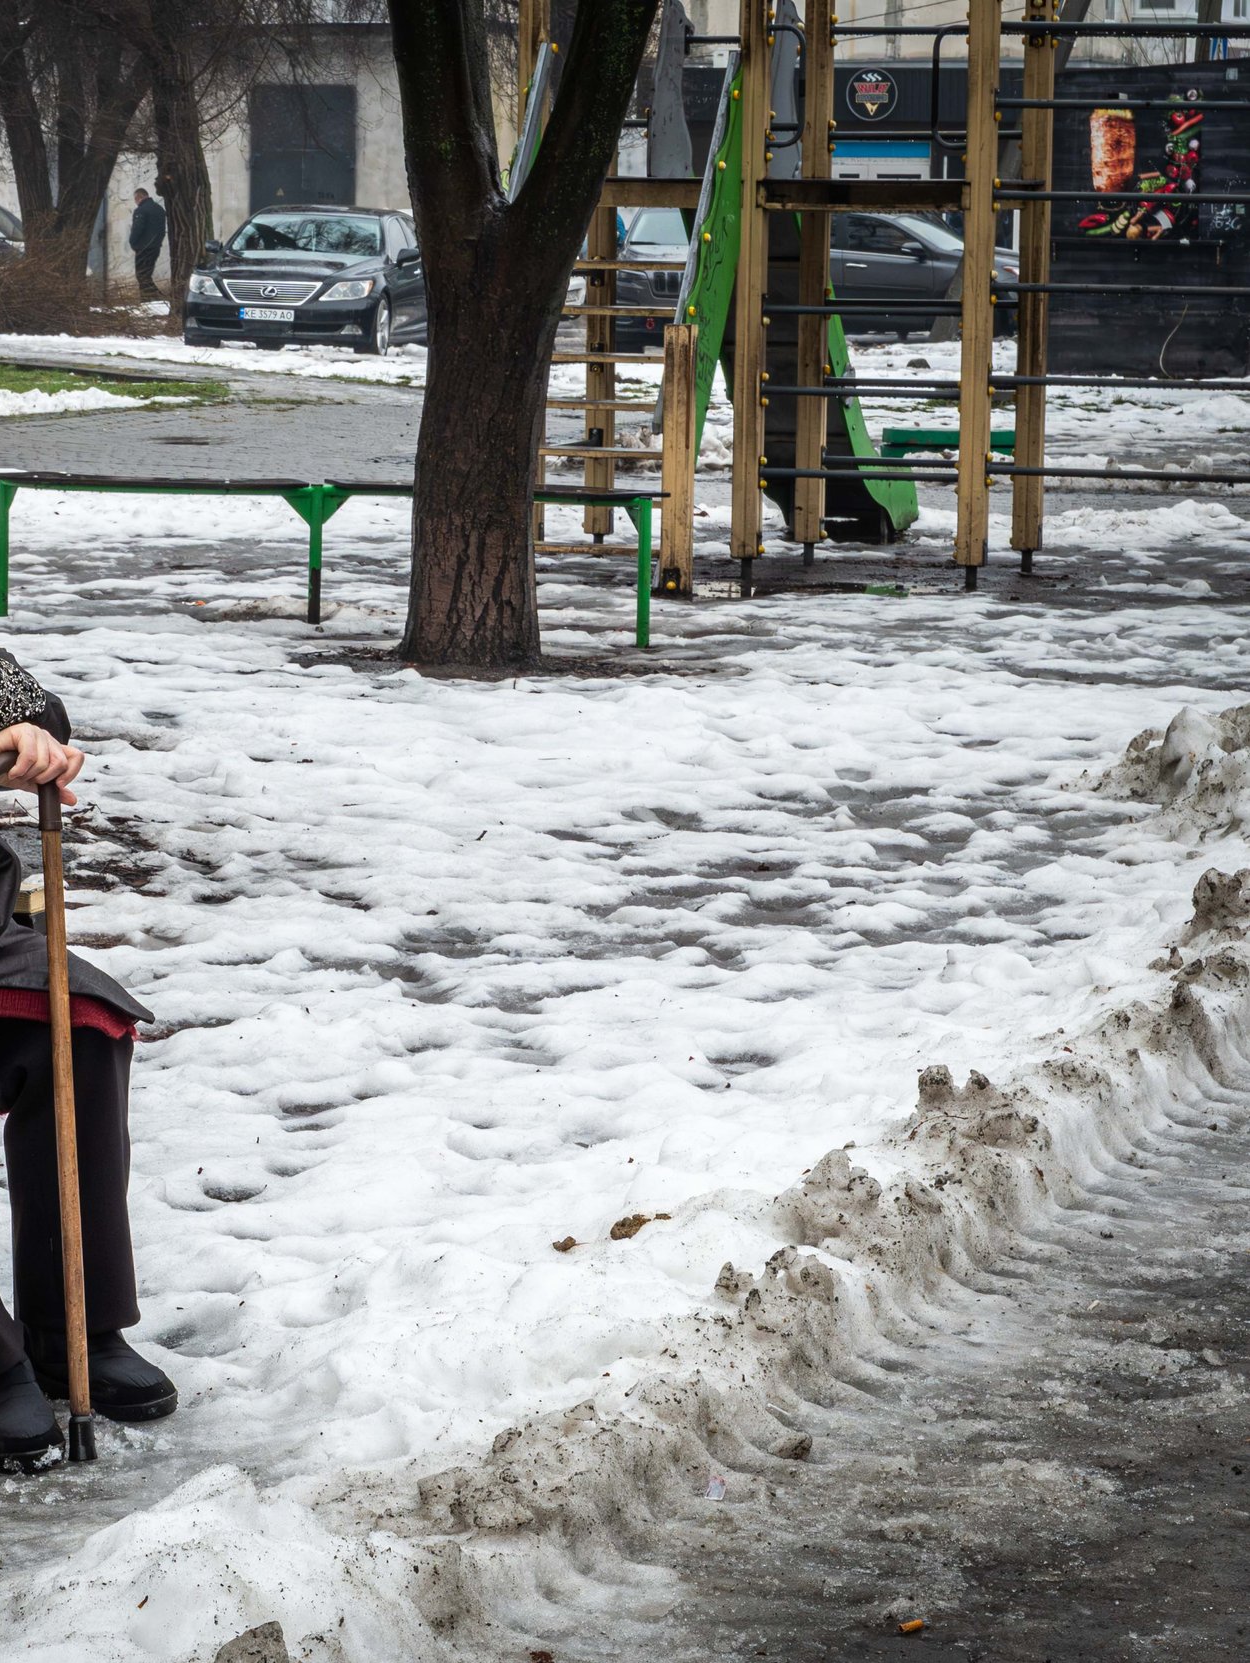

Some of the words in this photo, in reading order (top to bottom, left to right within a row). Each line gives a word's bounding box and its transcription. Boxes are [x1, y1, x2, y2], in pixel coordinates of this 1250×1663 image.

[245, 310, 256, 319] KE
[258, 310, 278, 320] 3579
[280, 311, 293, 320] AO
